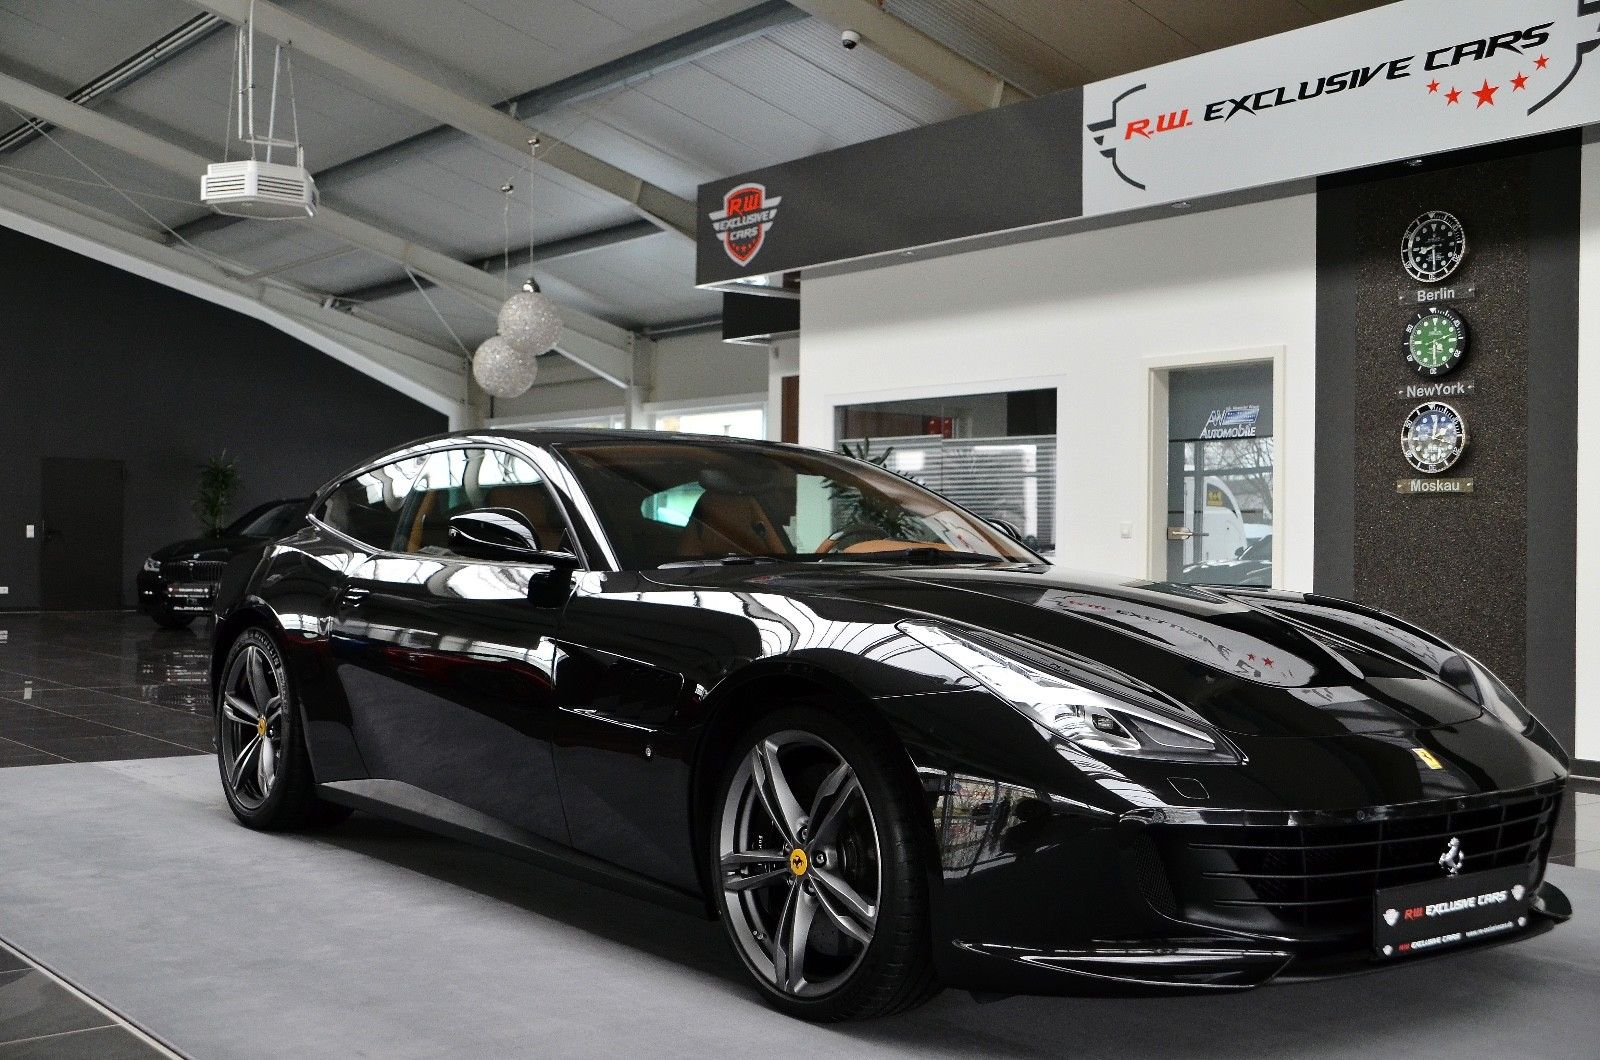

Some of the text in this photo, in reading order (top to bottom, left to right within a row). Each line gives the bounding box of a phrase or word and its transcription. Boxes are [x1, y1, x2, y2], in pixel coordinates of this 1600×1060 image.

[1124, 21, 1555, 140] R.W. EXCLUSIVE CARS
[730, 226, 758, 240] CARS
[1417, 287, 1455, 302] Berlin
[1410, 480, 1460, 492] Moskau
[1425, 896, 1477, 917] EXCLUSIVE
[1477, 890, 1508, 906] CARS
